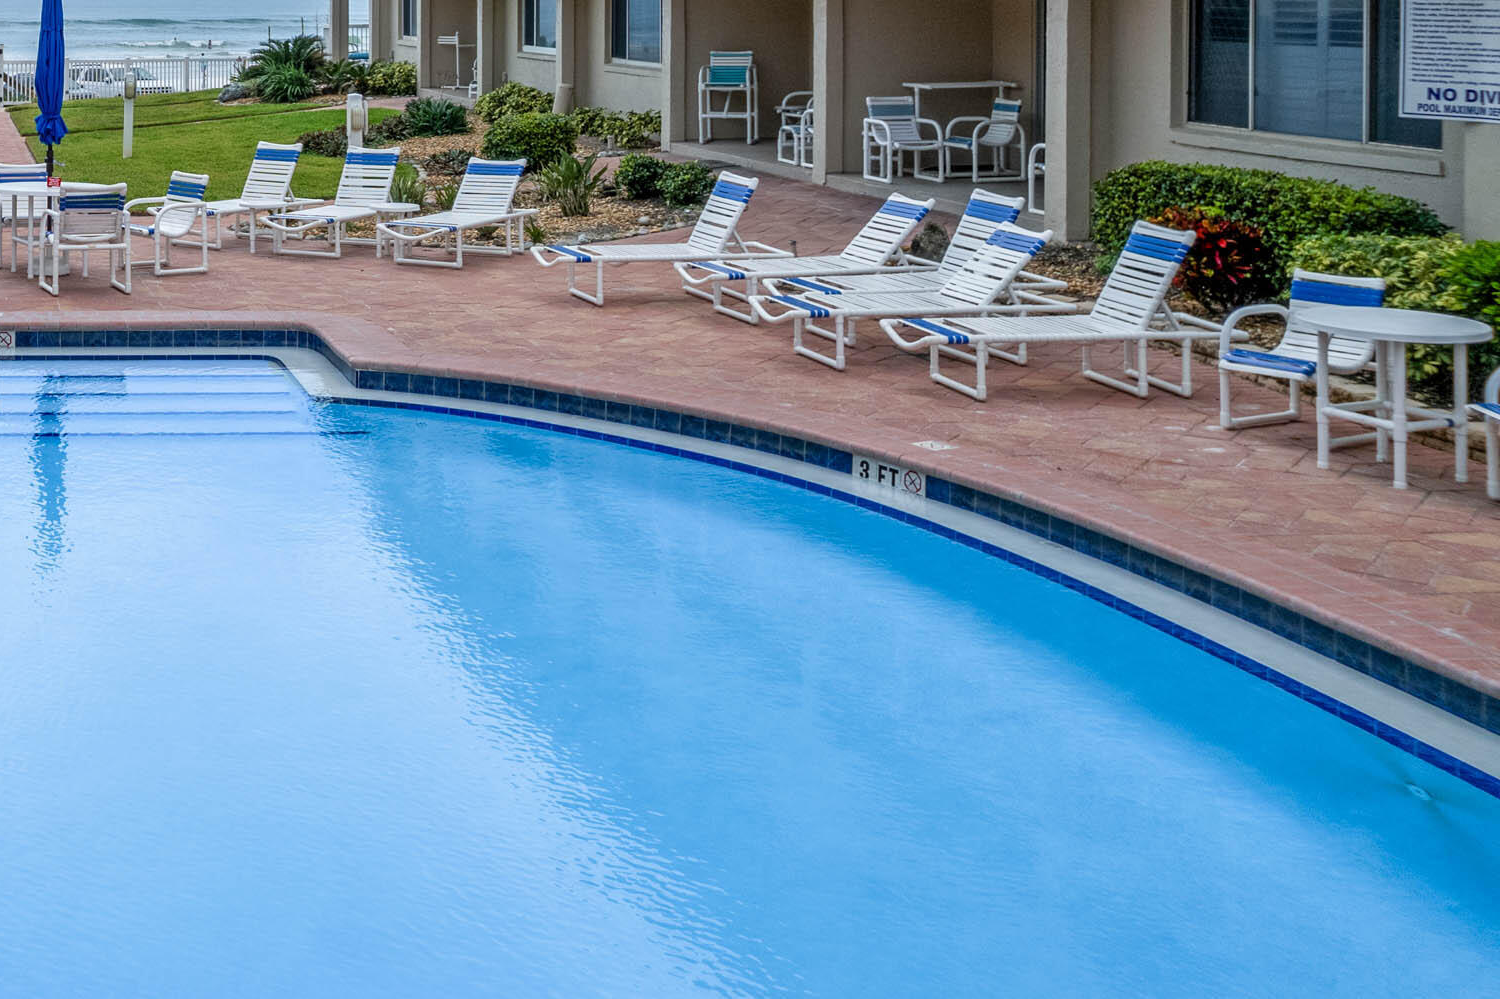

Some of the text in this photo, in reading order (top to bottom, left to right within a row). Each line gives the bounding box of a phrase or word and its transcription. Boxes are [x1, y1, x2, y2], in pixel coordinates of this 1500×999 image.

[1427, 87, 1457, 101] NO
[1417, 103, 1441, 113] POOL
[859, 460, 899, 487] 3 FT
